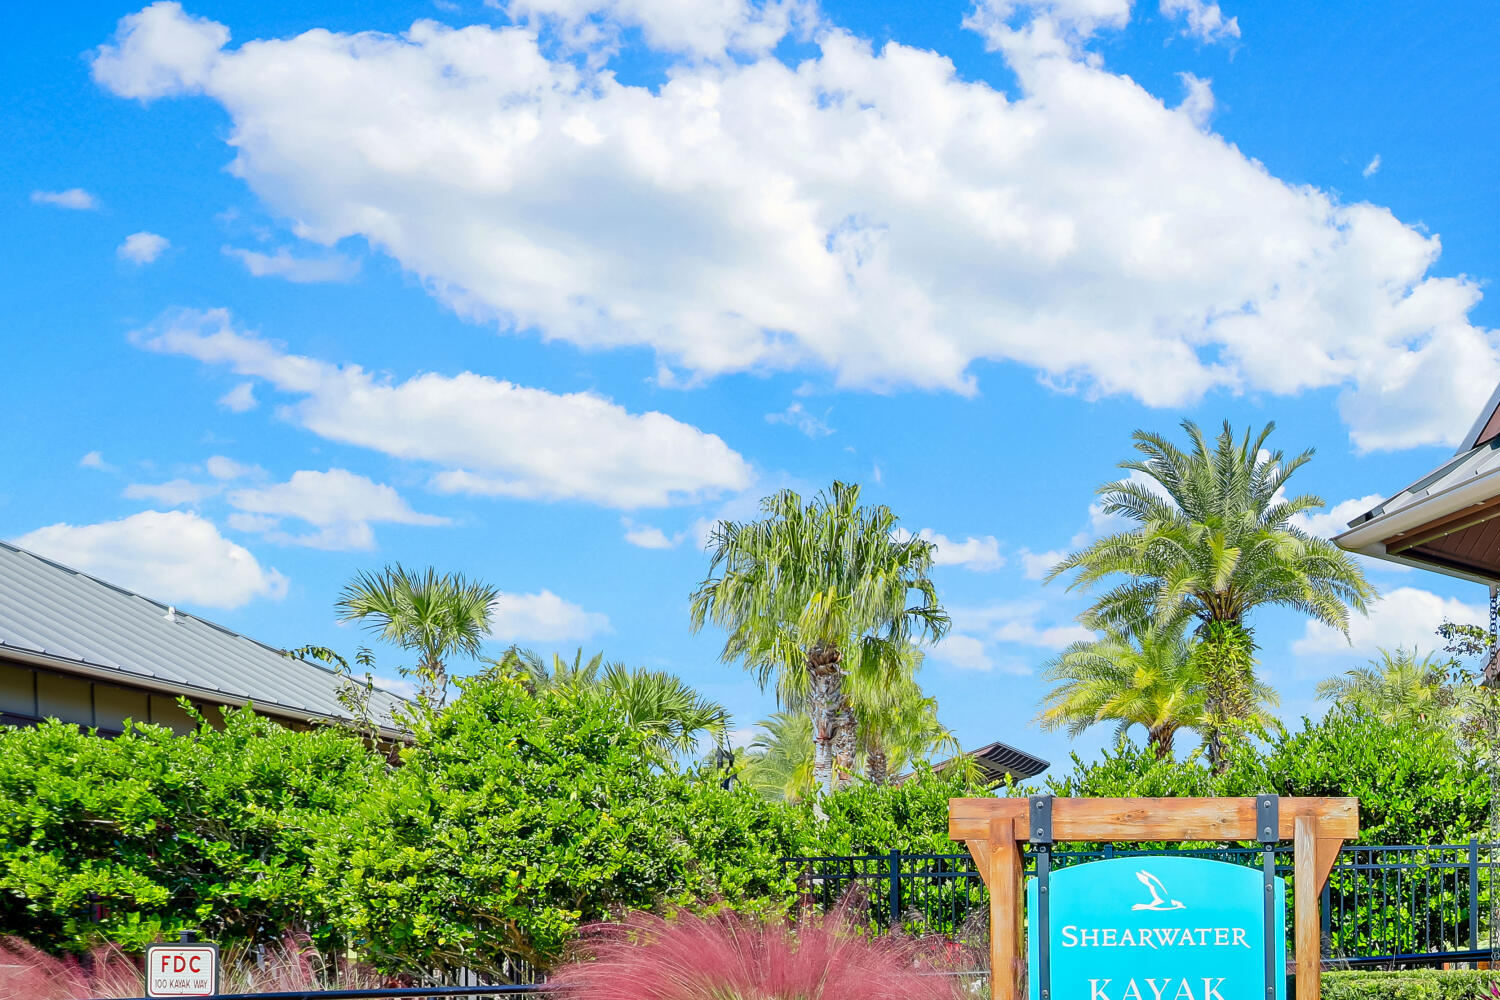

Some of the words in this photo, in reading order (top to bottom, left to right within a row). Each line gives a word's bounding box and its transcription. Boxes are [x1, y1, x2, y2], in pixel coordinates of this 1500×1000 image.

[1061, 925, 1251, 949] SHEARWATER
[162, 956, 201, 972] FDC
[154, 979, 168, 988] 100
[169, 979, 190, 988] KAYAK
[193, 979, 208, 988] WAY
